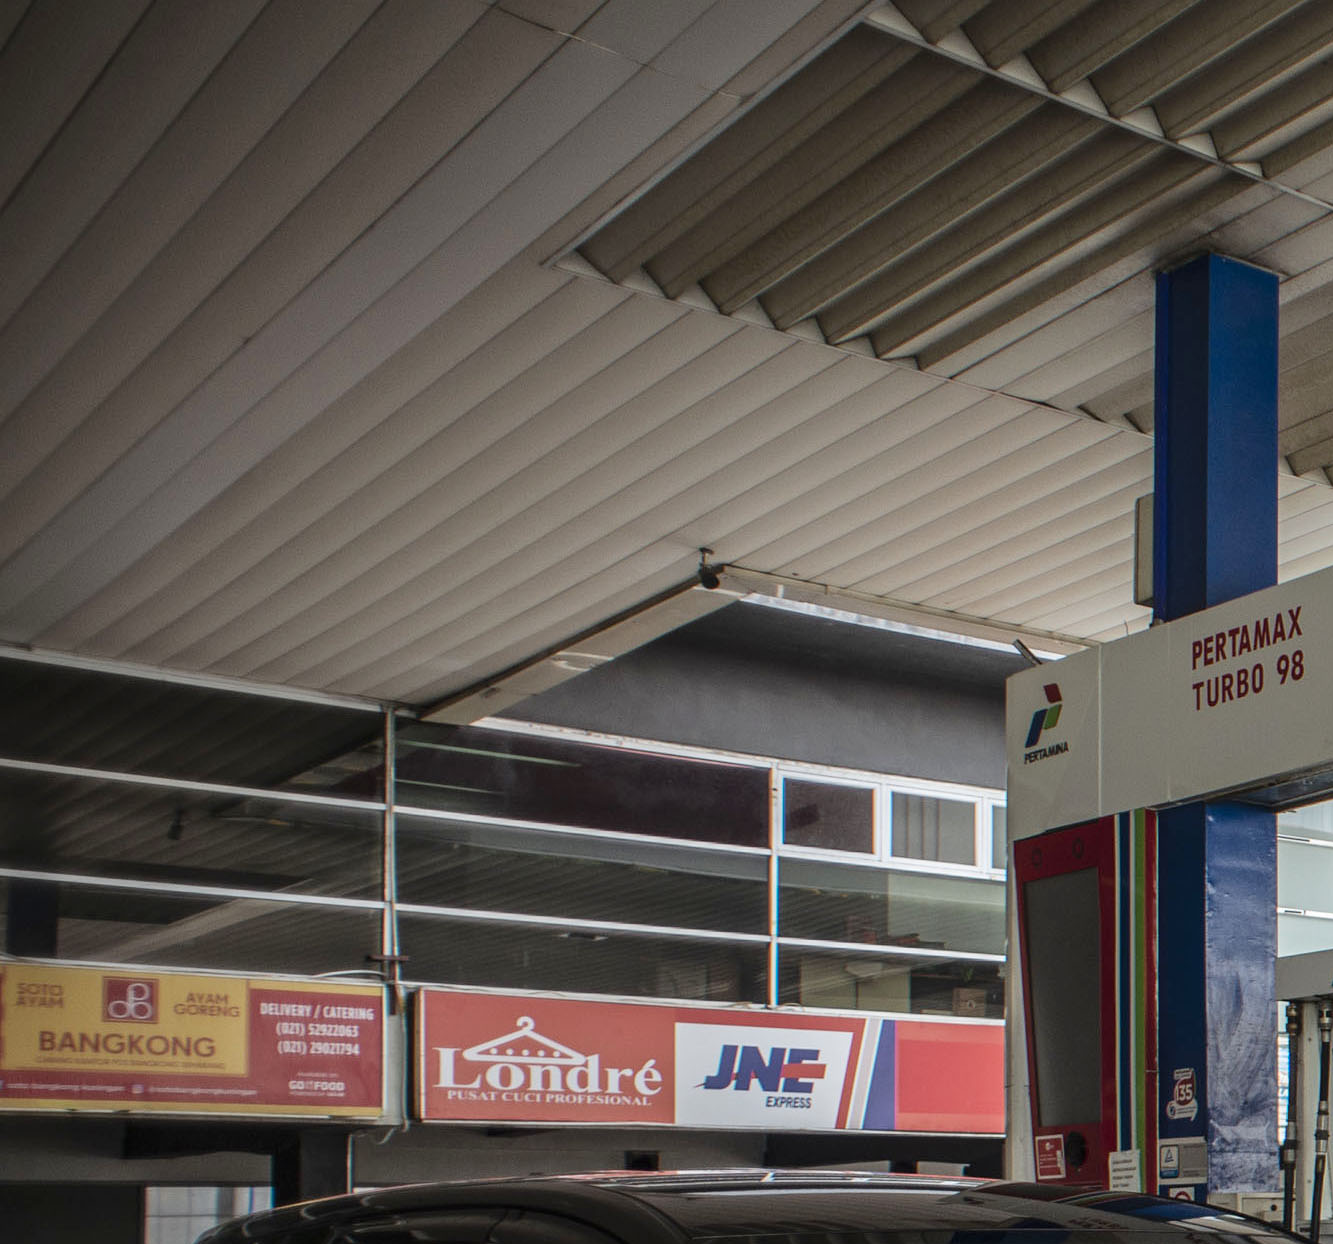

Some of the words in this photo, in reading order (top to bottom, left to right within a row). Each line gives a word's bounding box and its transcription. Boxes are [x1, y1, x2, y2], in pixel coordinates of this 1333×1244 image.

[1191, 607, 1303, 669] PERTAMAX
[1192, 663, 1265, 711] TURBO
[1276, 650, 1305, 686] 98
[1024, 741, 1069, 765] PERTAMINA
[16, 983, 64, 997] SOTO
[186, 992, 230, 1005] AYAM
[174, 1003, 240, 1018] GORENG
[260, 1001, 310, 1018] DELIVERY
[323, 1003, 375, 1021] CATERING
[276, 1022, 304, 1037] (021)
[39, 1030, 217, 1058] BANGKONG
[277, 1039, 306, 1055] (021)
[432, 1047, 662, 1096] Londré
[703, 1044, 827, 1094] JNE
[447, 1090, 497, 1102] PUSAT
[501, 1092, 542, 1104] CUCI
[545, 1093, 652, 1106] PROFESIONAL
[1176, 1083, 1193, 1101] 135
[766, 1096, 812, 1109] EXPRESS
